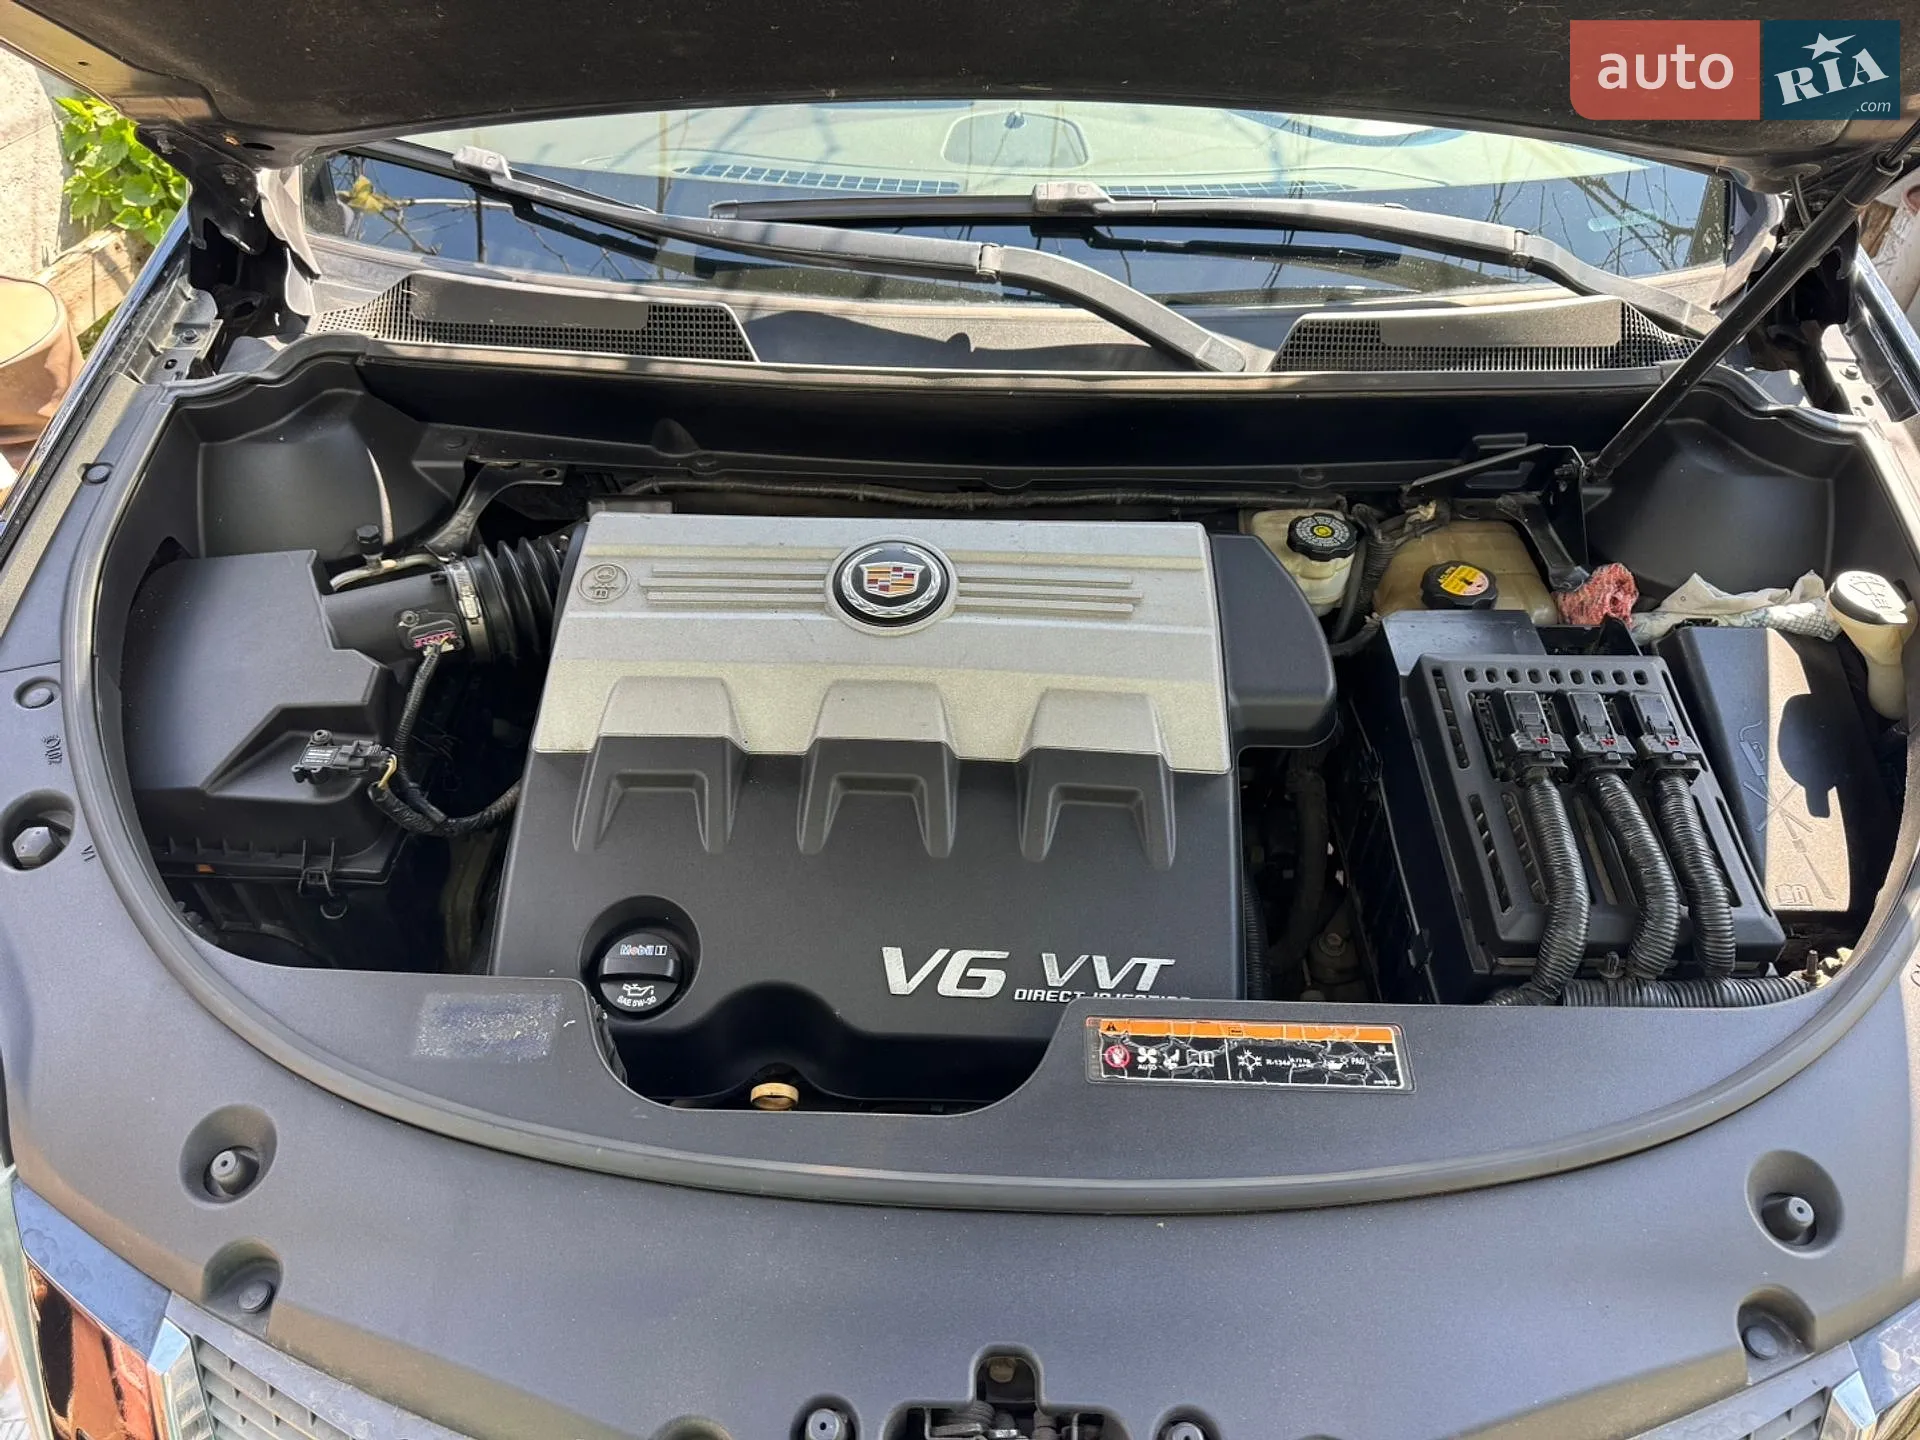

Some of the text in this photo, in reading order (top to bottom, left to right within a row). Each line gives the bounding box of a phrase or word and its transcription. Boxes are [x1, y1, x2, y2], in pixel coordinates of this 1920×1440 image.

[620, 945, 653, 955] Mobil
[881, 946, 1176, 999] V6 VVT
